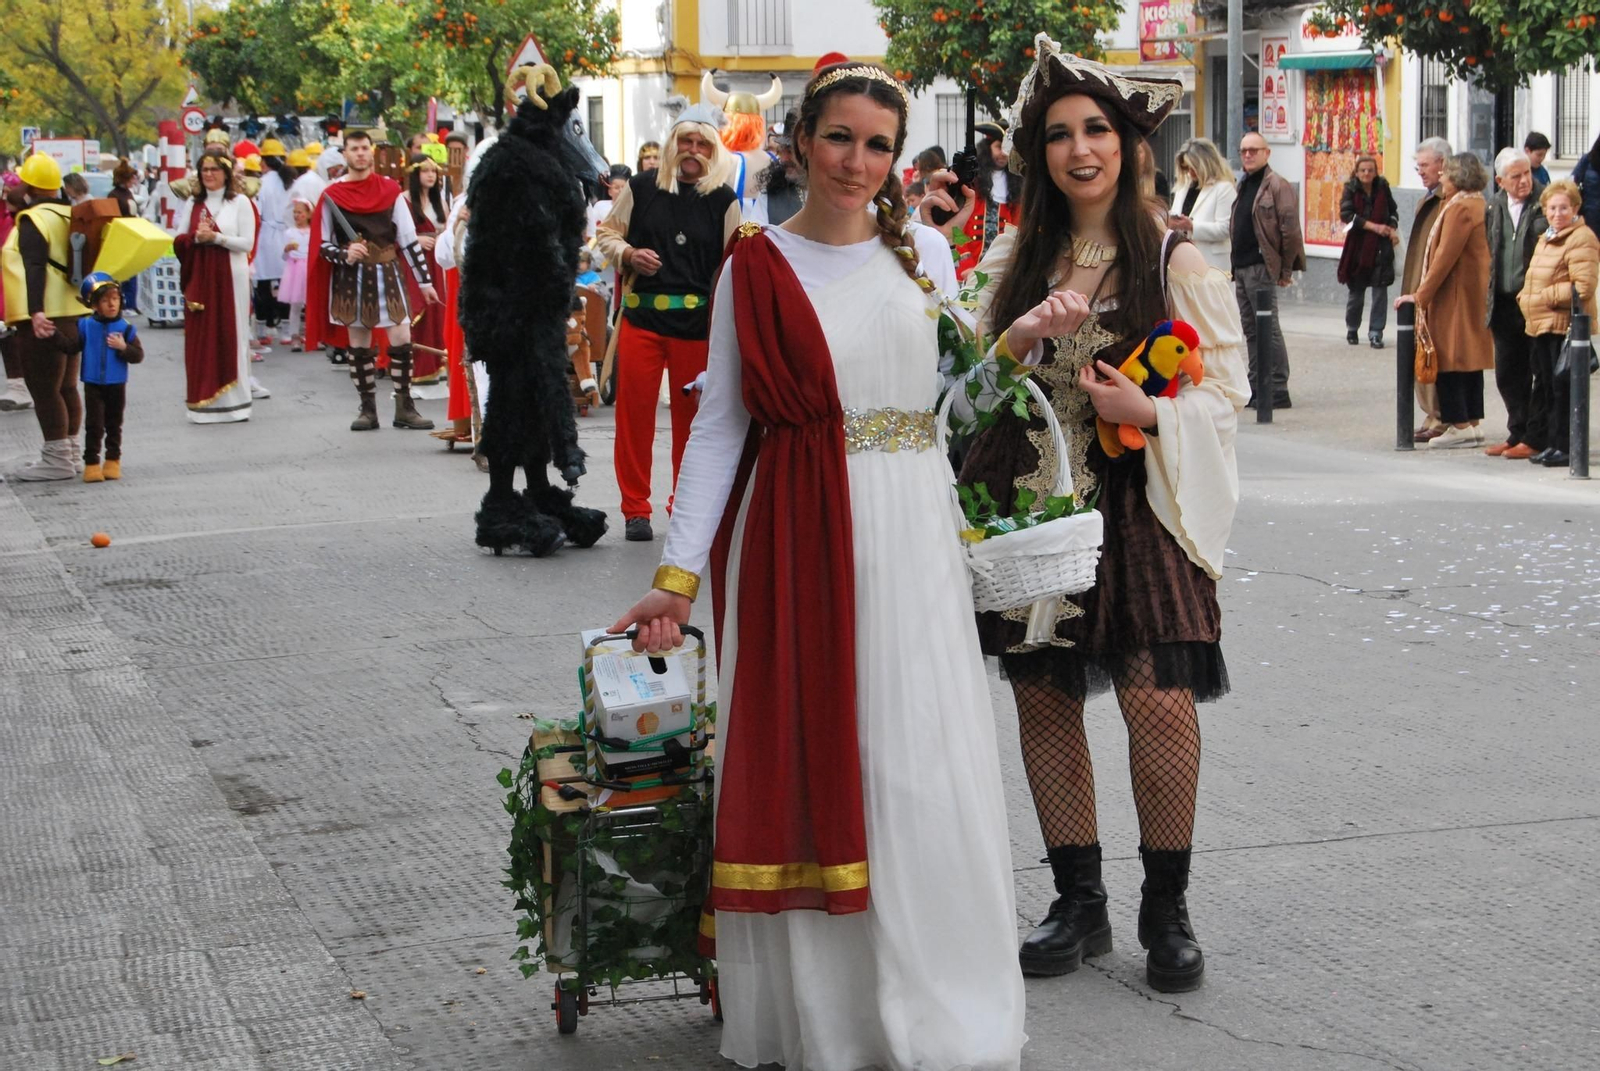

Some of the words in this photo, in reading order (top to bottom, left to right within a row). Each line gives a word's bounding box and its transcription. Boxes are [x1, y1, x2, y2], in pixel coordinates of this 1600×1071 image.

[1144, 4, 1194, 21] KIOSKO
[1156, 22, 1179, 38] LAS
[1154, 41, 1170, 56] 24
